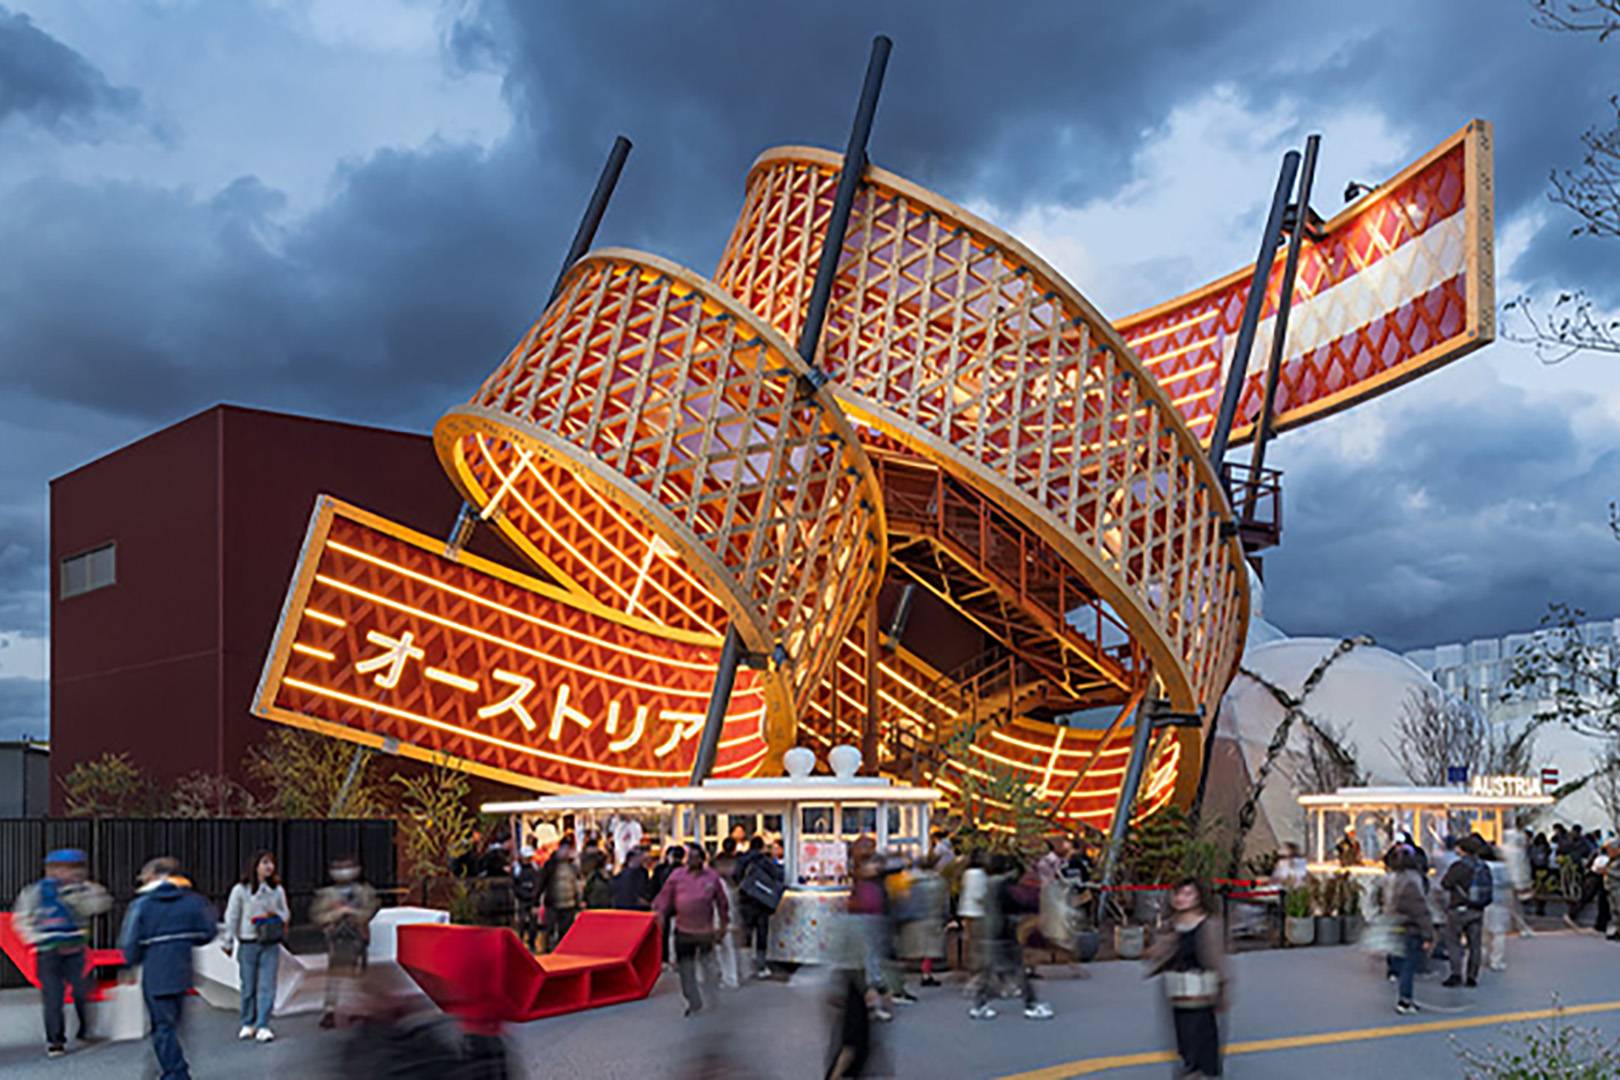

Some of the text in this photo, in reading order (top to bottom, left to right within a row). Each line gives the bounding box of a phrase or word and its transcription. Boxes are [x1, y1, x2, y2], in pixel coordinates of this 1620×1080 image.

[355, 630, 705, 756] オーストリア
[1471, 775, 1542, 796] AUSTRIA
